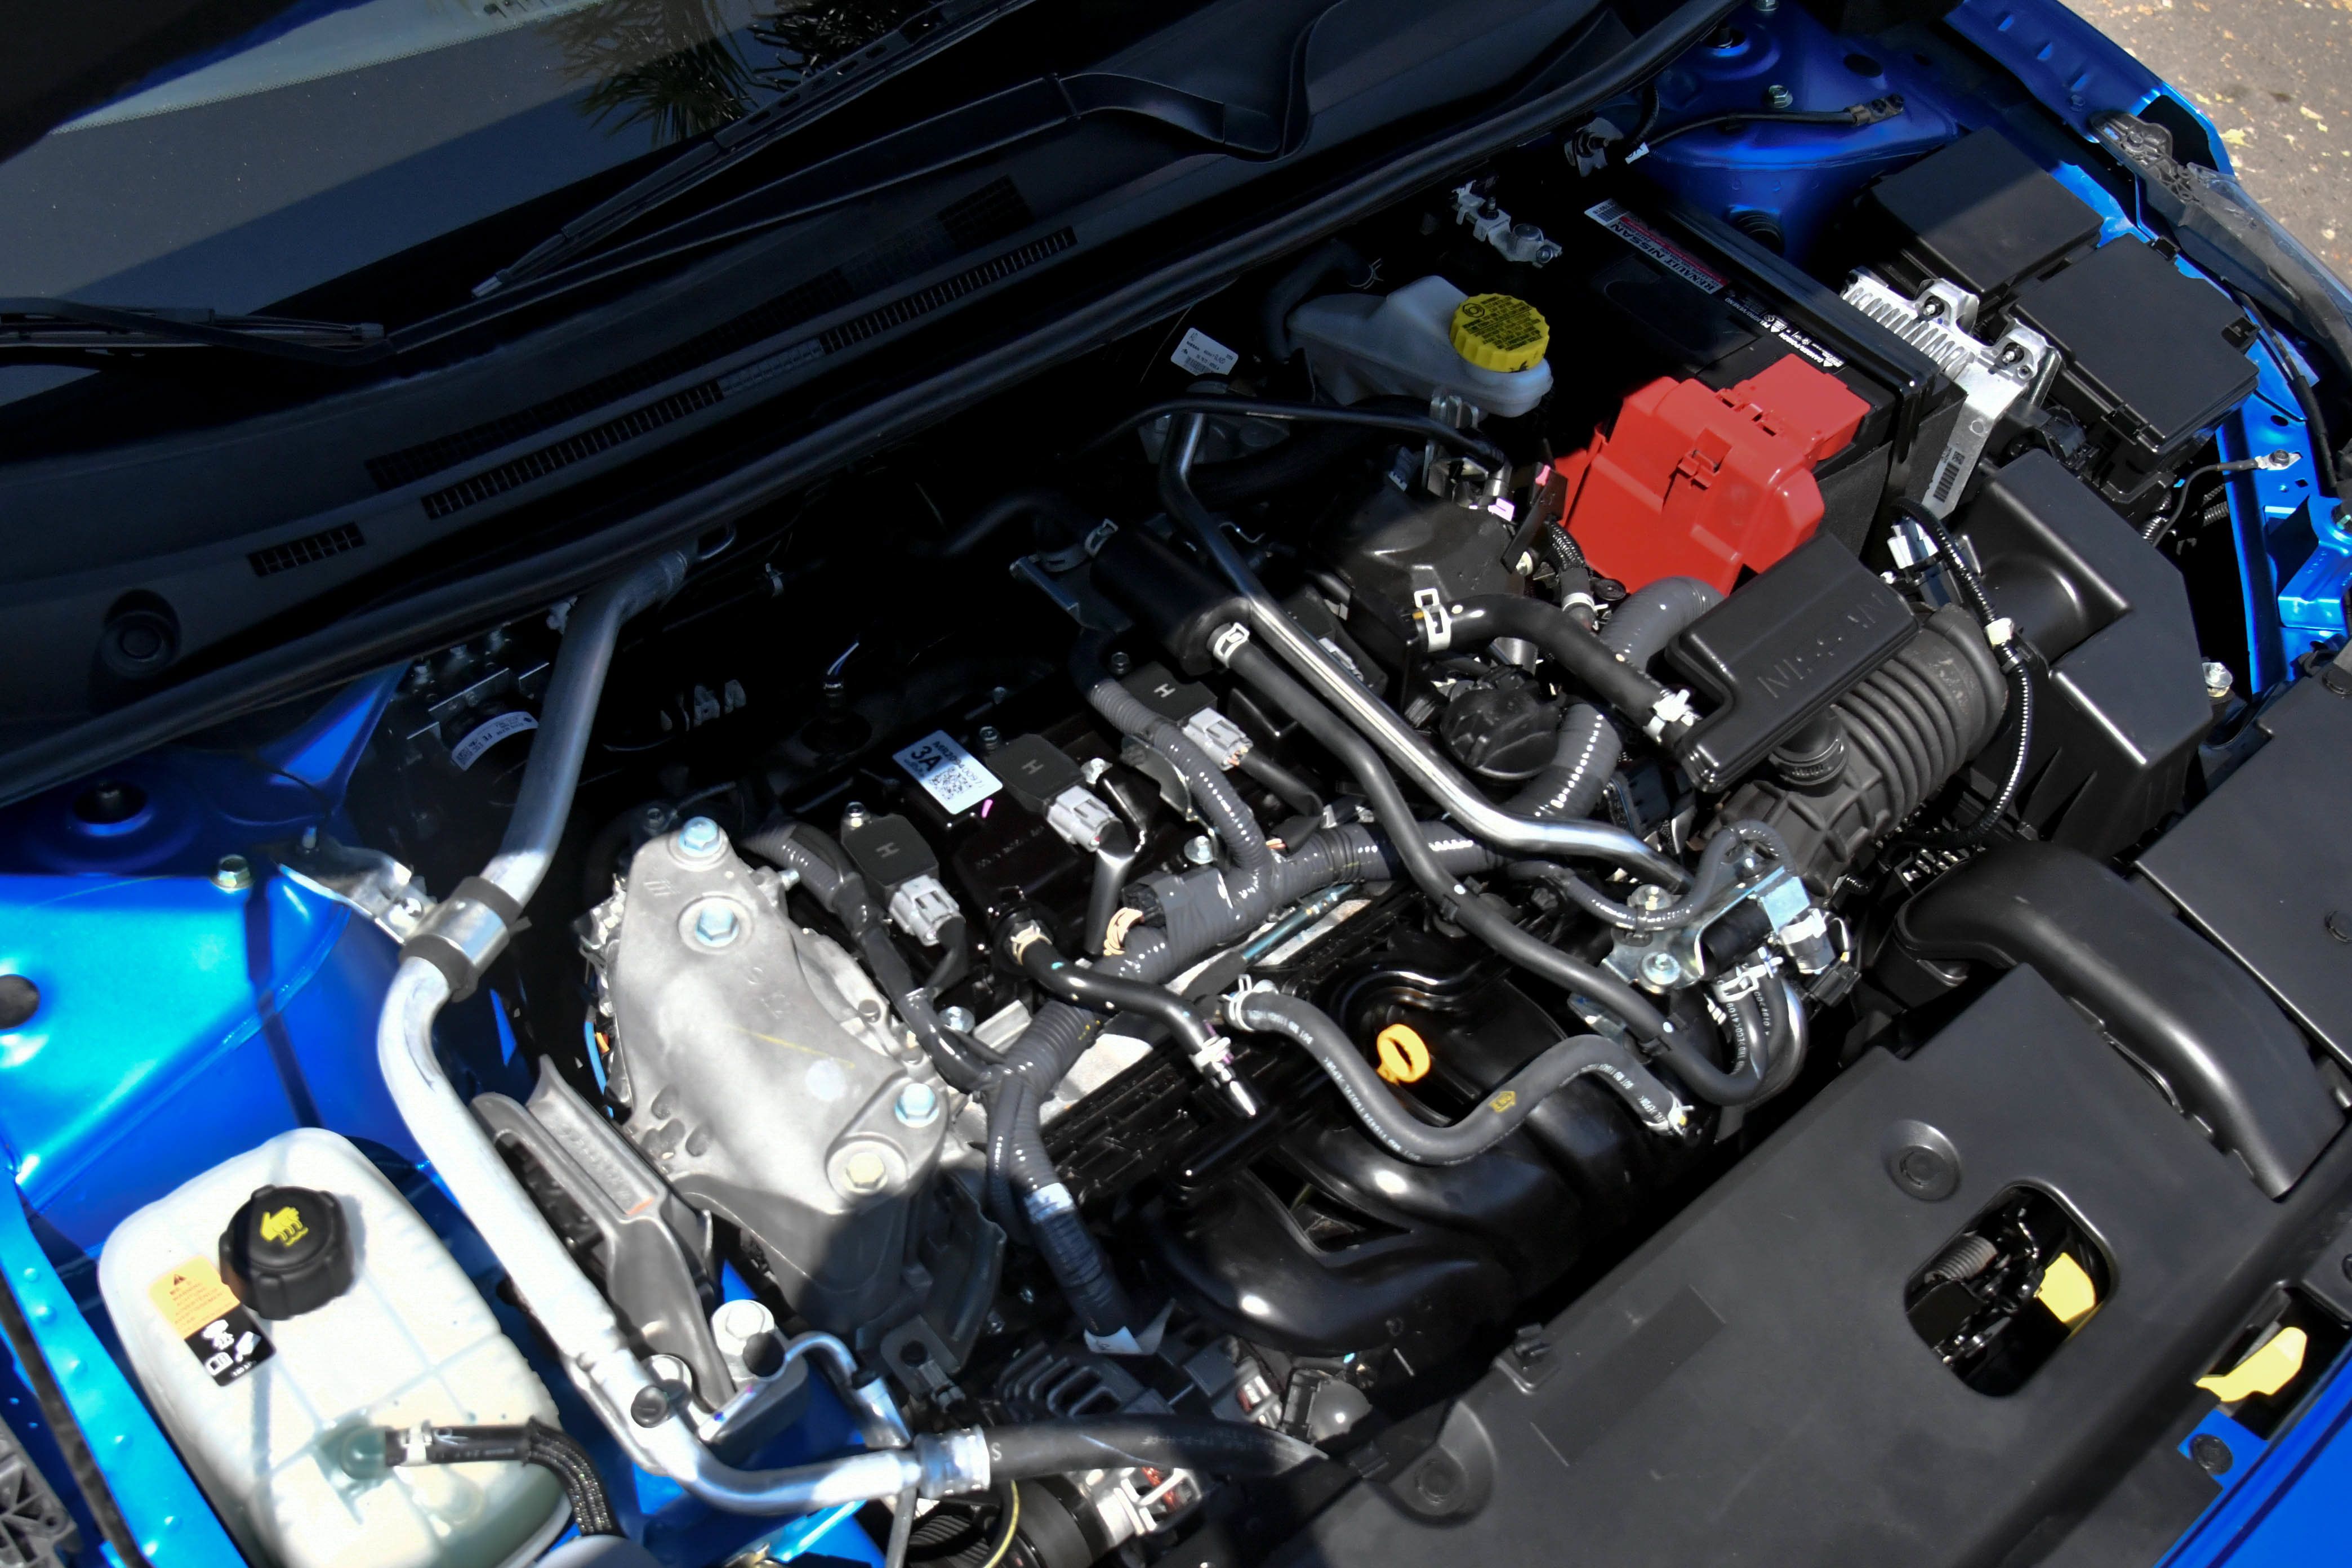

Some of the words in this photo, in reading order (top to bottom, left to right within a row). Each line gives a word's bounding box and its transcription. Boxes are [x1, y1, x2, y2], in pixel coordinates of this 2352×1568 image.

[1611, 224, 1665, 260] NISSAN
[1665, 259, 1714, 291] RENAULT
[1153, 683, 1175, 698] H
[911, 746, 943, 772] 3A
[1021, 759, 1044, 775] H
[876, 842, 899, 858] H
[990, 1441, 1003, 1461] S
